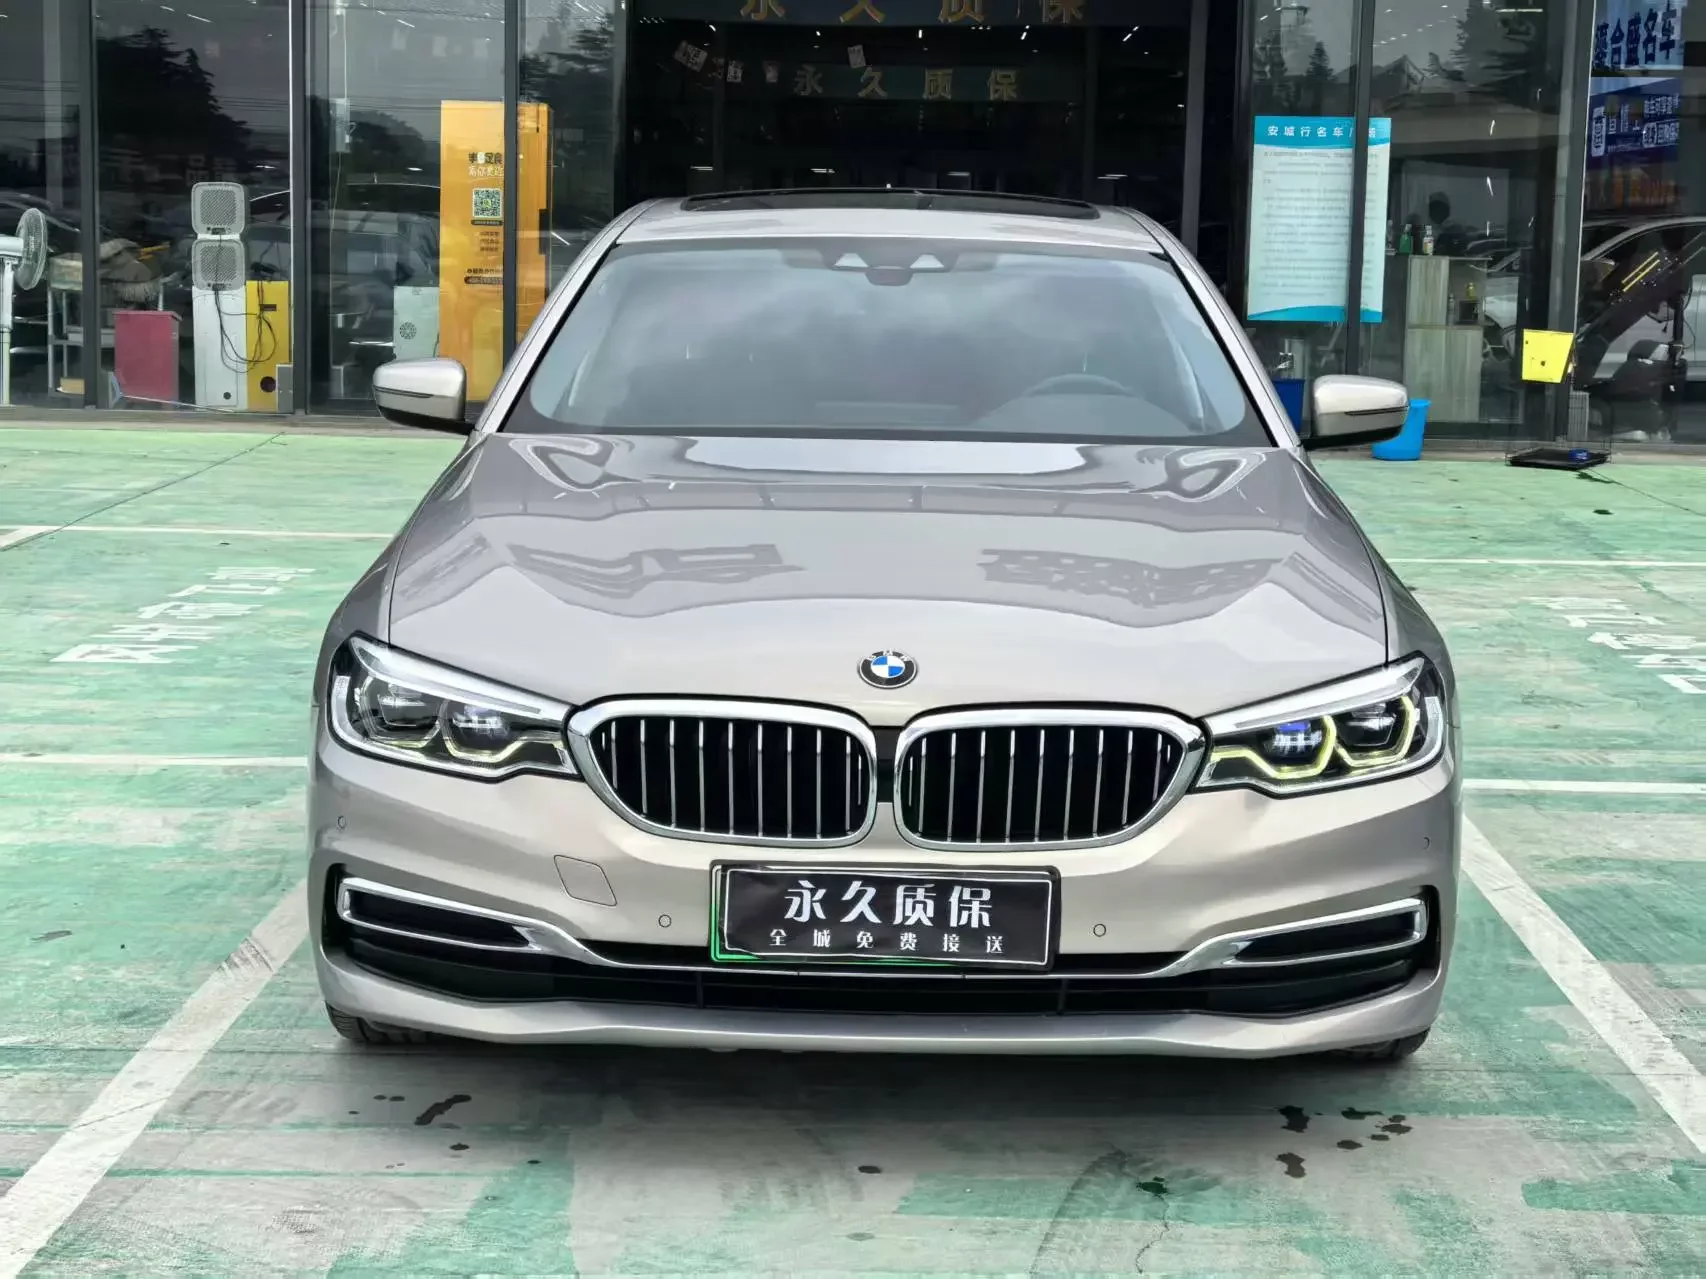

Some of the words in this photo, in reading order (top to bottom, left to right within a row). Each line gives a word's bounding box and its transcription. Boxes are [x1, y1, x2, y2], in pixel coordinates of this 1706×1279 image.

[794, 65, 1018, 102] 永久质保
[783, 879, 992, 929] 永久质保
[769, 929, 1005, 954] 全城免费接送
